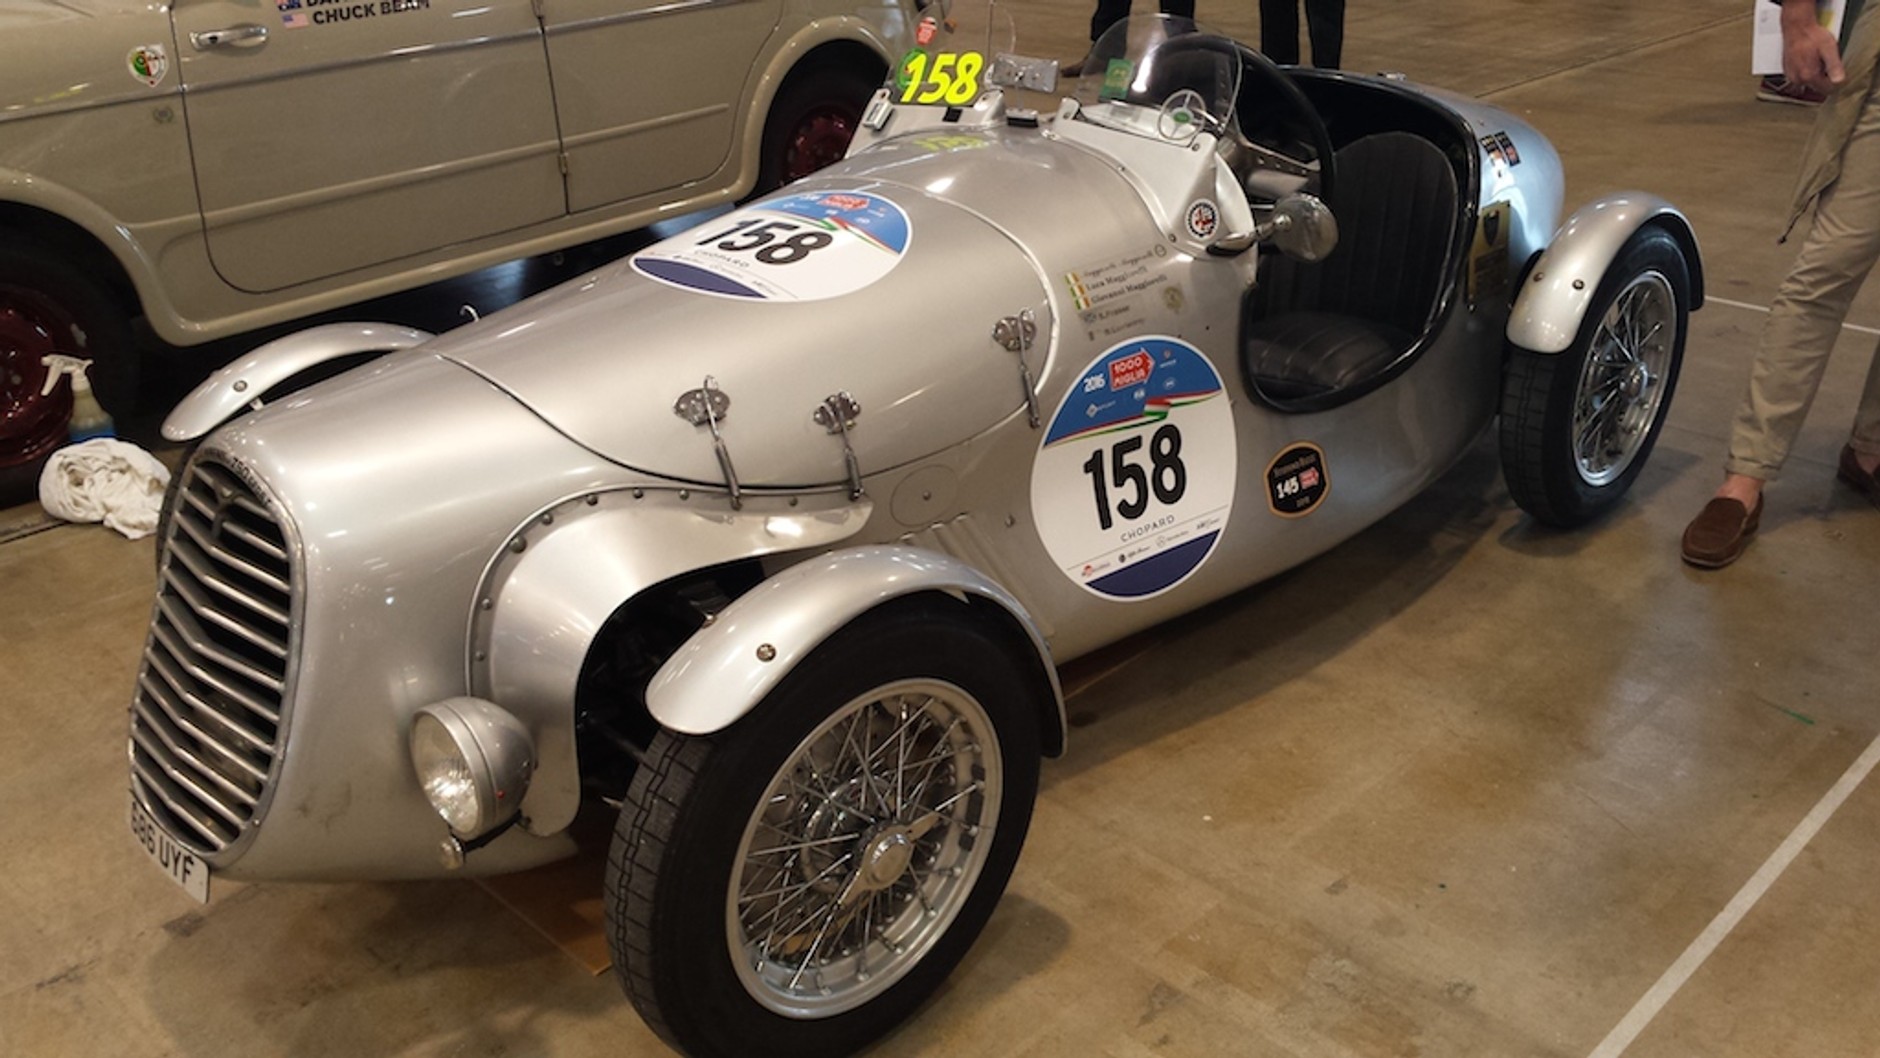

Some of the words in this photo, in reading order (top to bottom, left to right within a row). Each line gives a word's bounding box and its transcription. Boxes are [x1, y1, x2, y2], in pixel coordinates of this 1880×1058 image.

[312, 5, 376, 25] CHUCK
[900, 52, 984, 105] 158
[693, 217, 834, 266] 158
[1113, 355, 1144, 375] 1000
[1113, 367, 1146, 389] MIGLIA
[1083, 423, 1187, 531] 158
[1276, 476, 1299, 499] 145
[1120, 514, 1175, 543] CHOPARD
[159, 834, 194, 885] UYF
